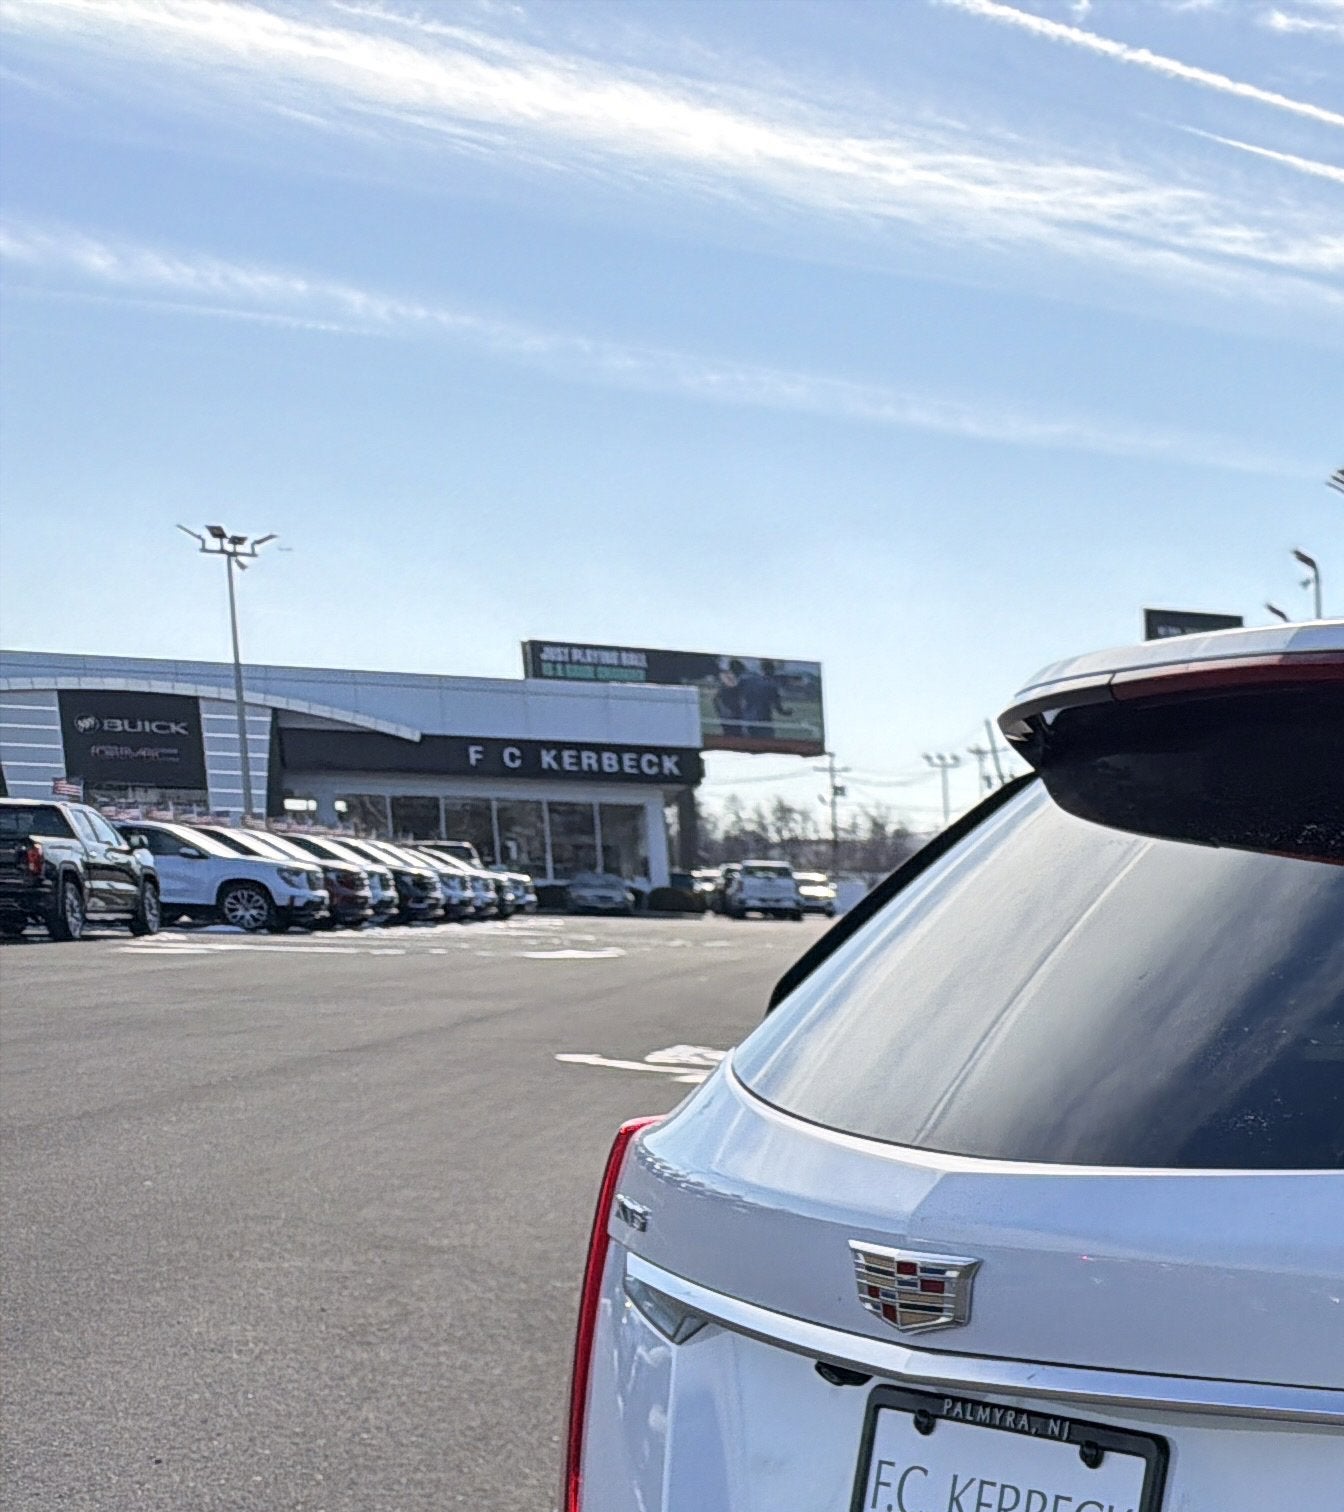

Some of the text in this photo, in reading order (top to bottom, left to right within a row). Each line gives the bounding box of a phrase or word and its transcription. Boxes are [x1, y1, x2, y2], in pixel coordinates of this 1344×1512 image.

[103, 718, 189, 735] BUICK
[468, 745, 682, 776] F C KERBECK
[942, 1399, 1071, 1441] PALMYRA, NJ
